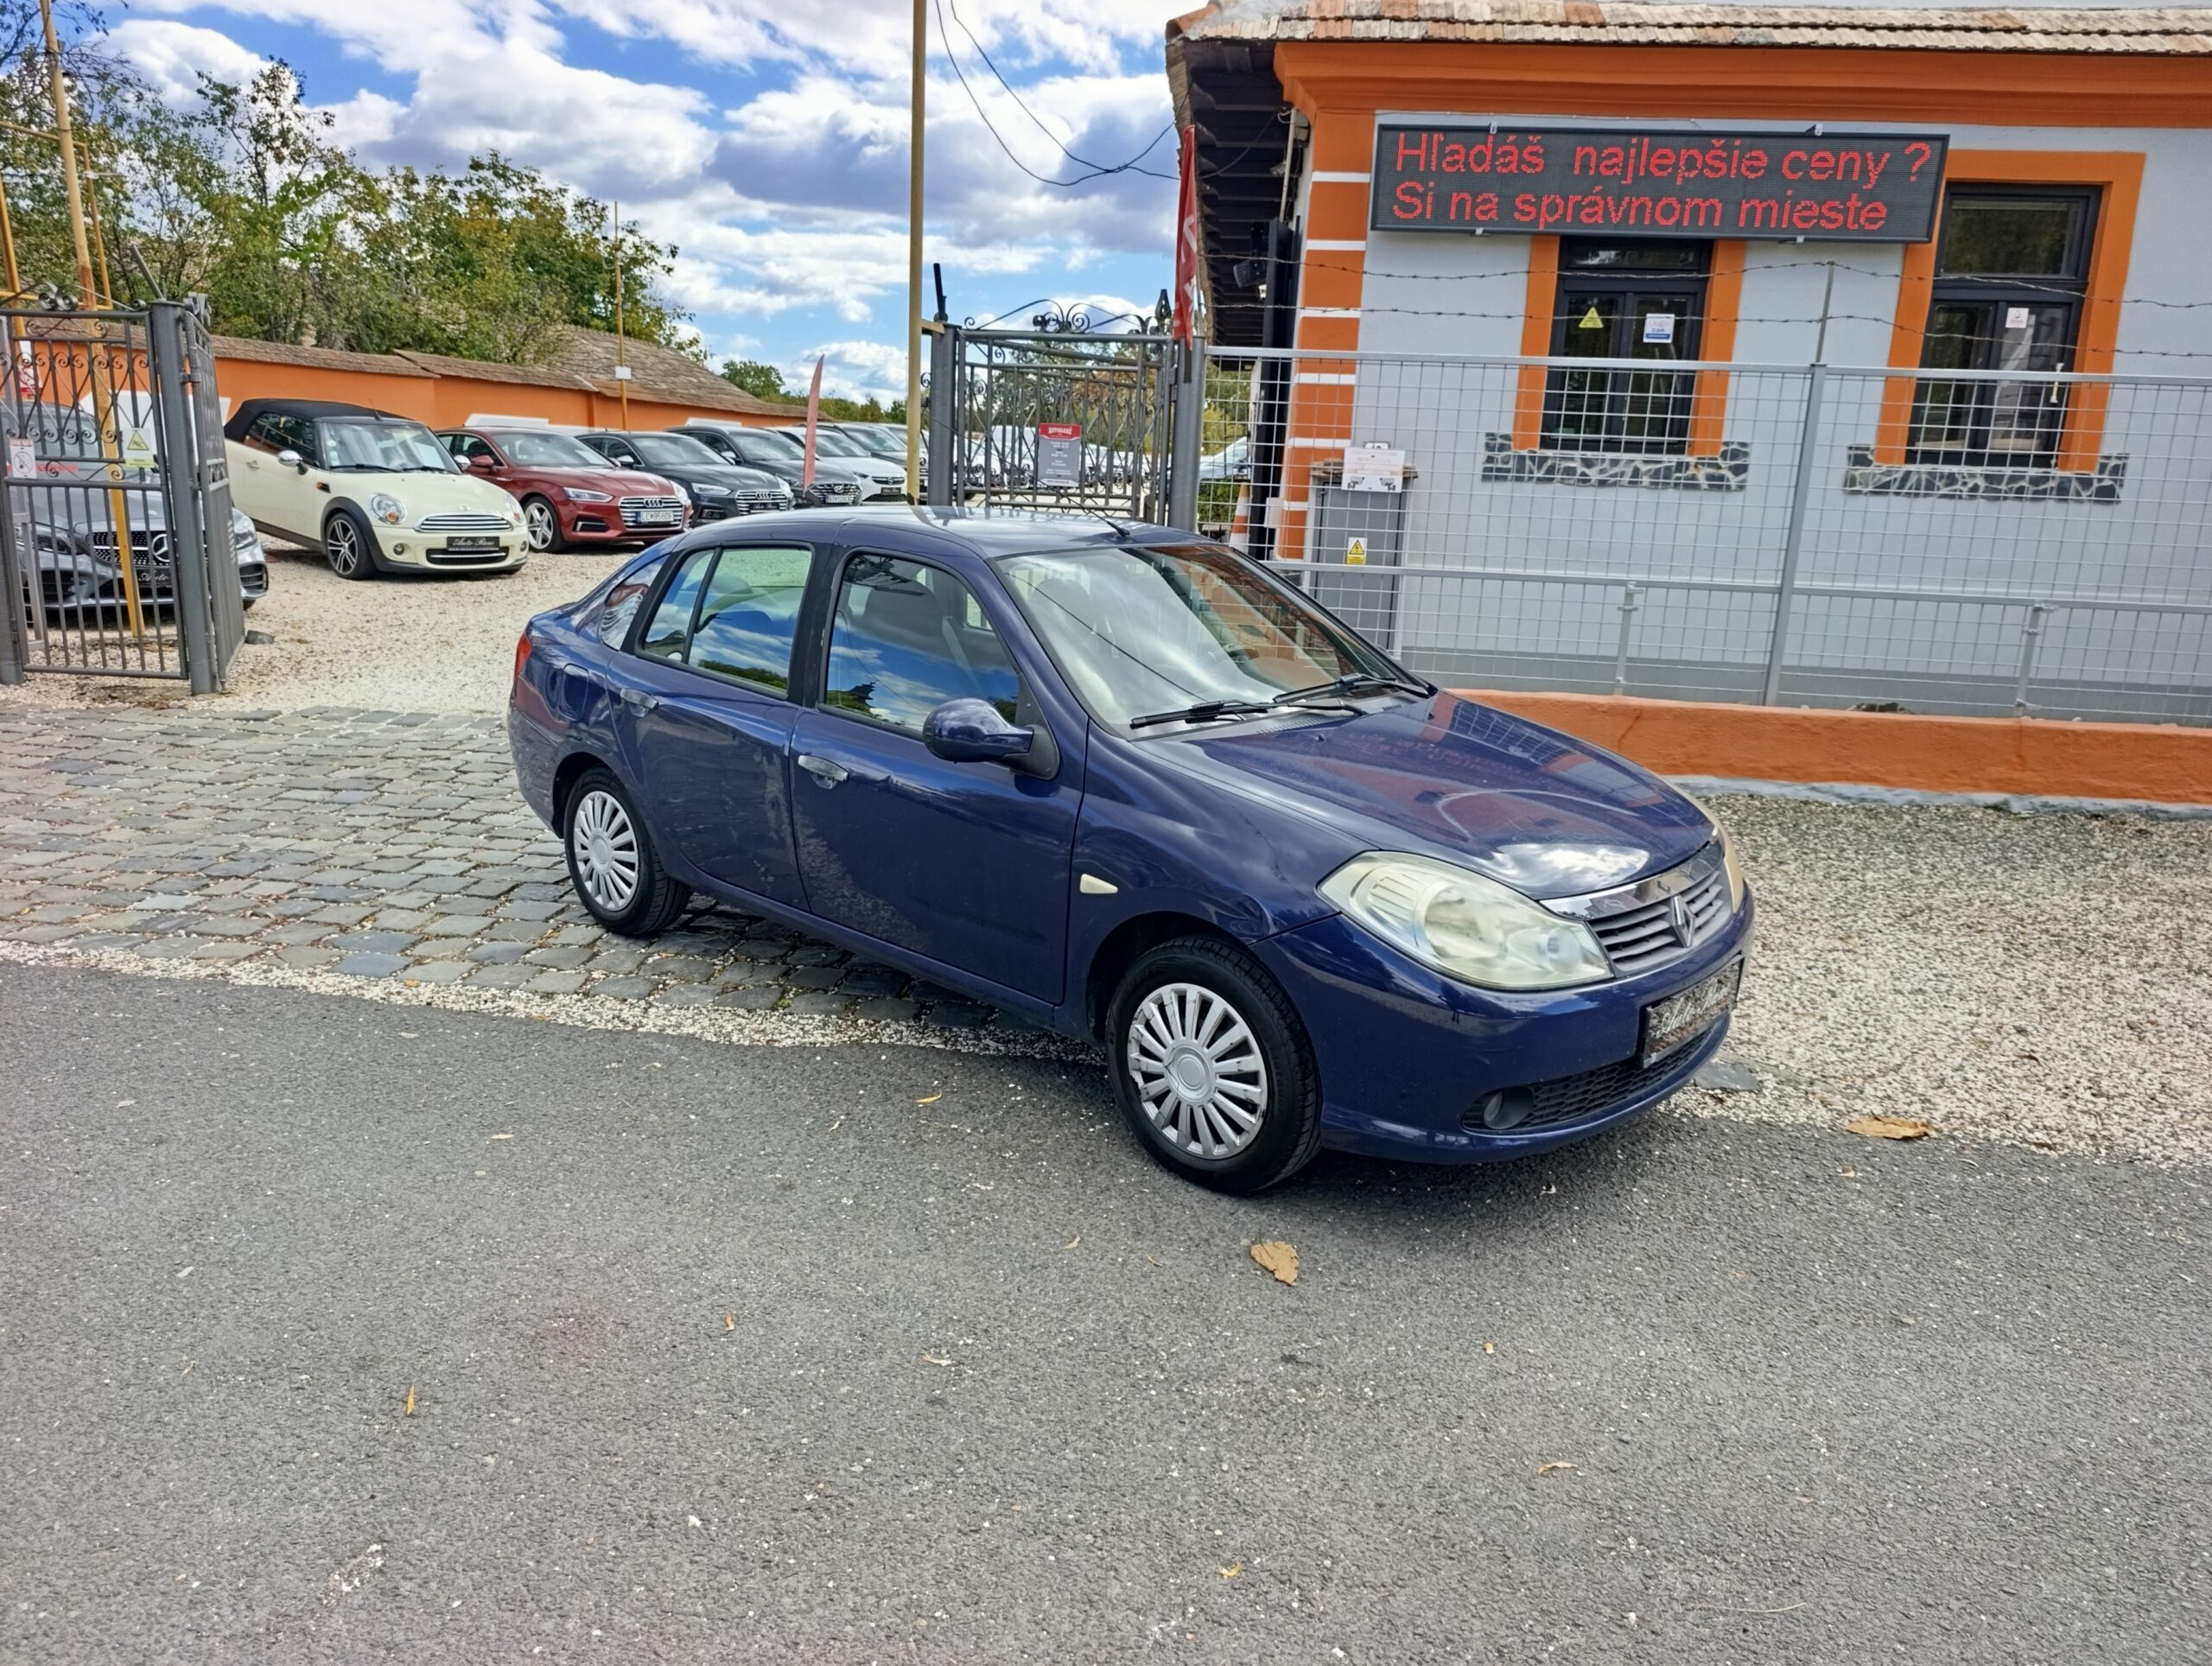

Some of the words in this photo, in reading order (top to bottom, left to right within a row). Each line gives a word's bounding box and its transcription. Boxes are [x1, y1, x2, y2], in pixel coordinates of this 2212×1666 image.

[1396, 132, 1545, 174] Hľadáš
[1573, 137, 1769, 186] najlepšie
[1782, 149, 1891, 189] ceny
[1904, 142, 1931, 182] ?
[1393, 181, 1434, 220] Si
[1450, 192, 1499, 221] na
[1514, 185, 1723, 230] správnom
[1738, 189, 1887, 231] mieste
